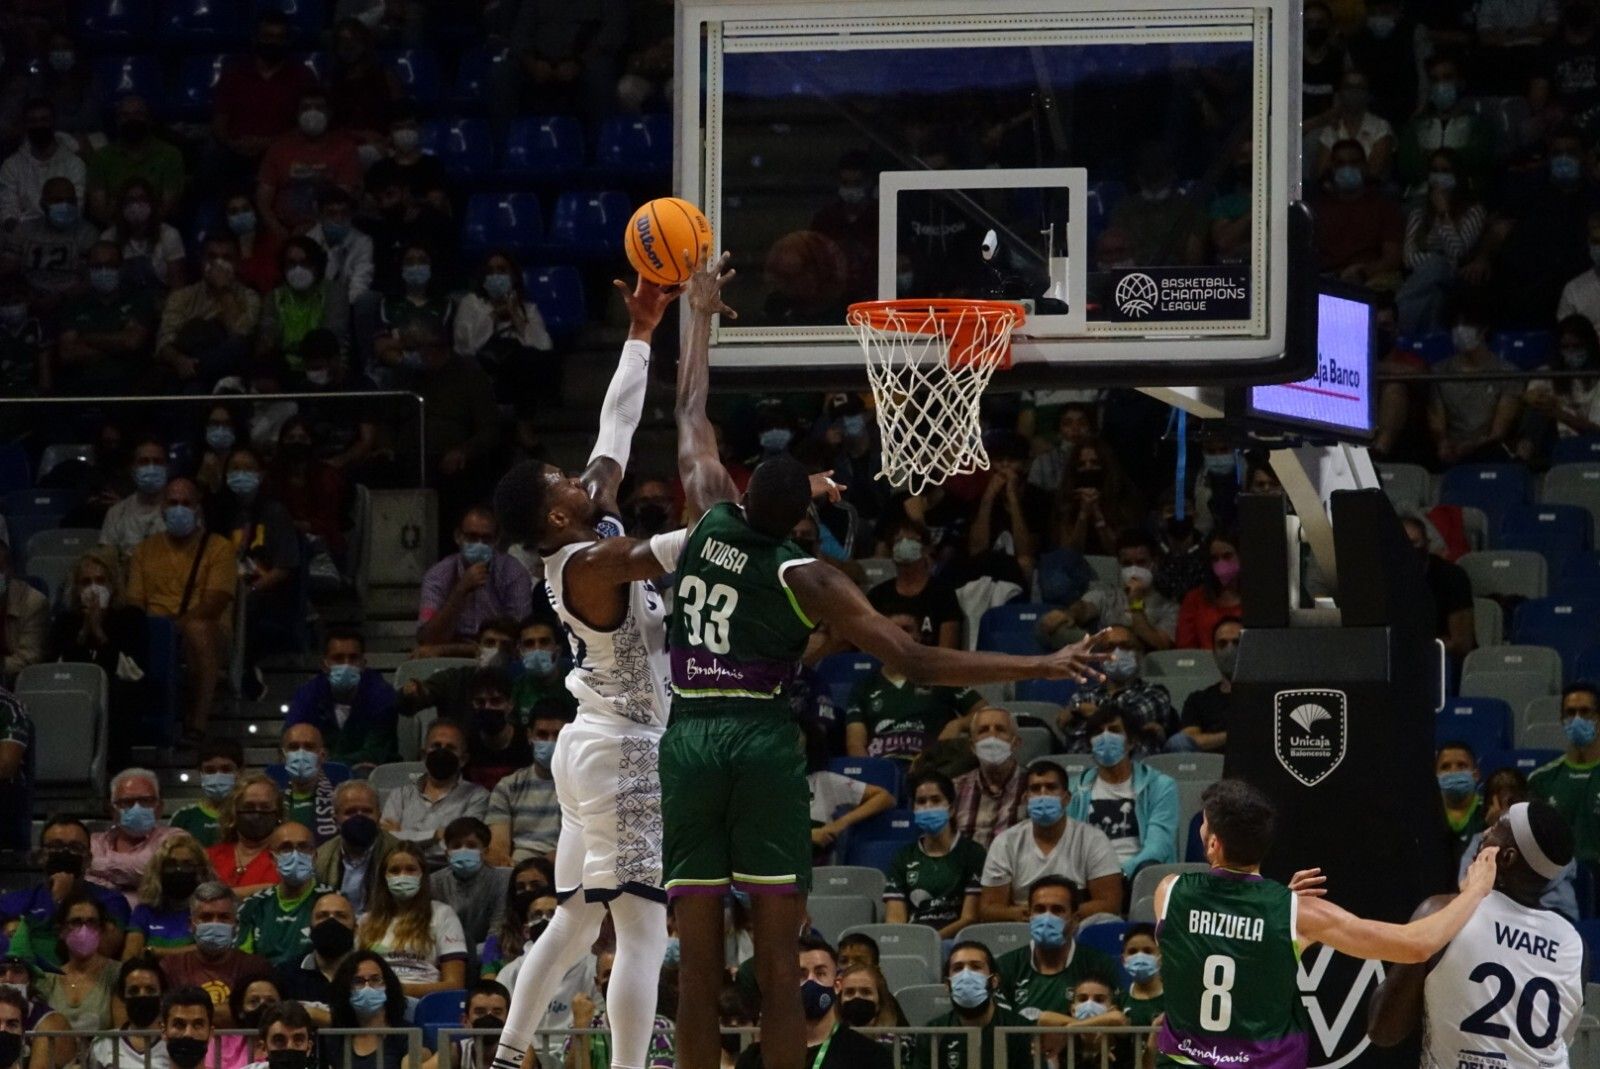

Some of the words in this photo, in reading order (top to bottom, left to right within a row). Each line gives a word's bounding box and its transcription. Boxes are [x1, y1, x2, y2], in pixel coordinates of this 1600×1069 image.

[636, 216, 664, 270] Wilson
[1161, 277, 1236, 289] BASKETBALL
[1161, 288, 1246, 301] CHAMPIONS
[1161, 301, 1207, 312] LEAGUE
[1329, 358, 1360, 388] Banco
[700, 536, 749, 575] NZOSA
[678, 574, 740, 655] 33
[1289, 735, 1331, 749] Unicaja
[1289, 749, 1332, 758] Baloncesto
[1188, 908, 1265, 943] BRIZUELA
[1495, 921, 1560, 963] WARE
[1200, 953, 1236, 1033] 8
[1460, 961, 1562, 1049] 20
